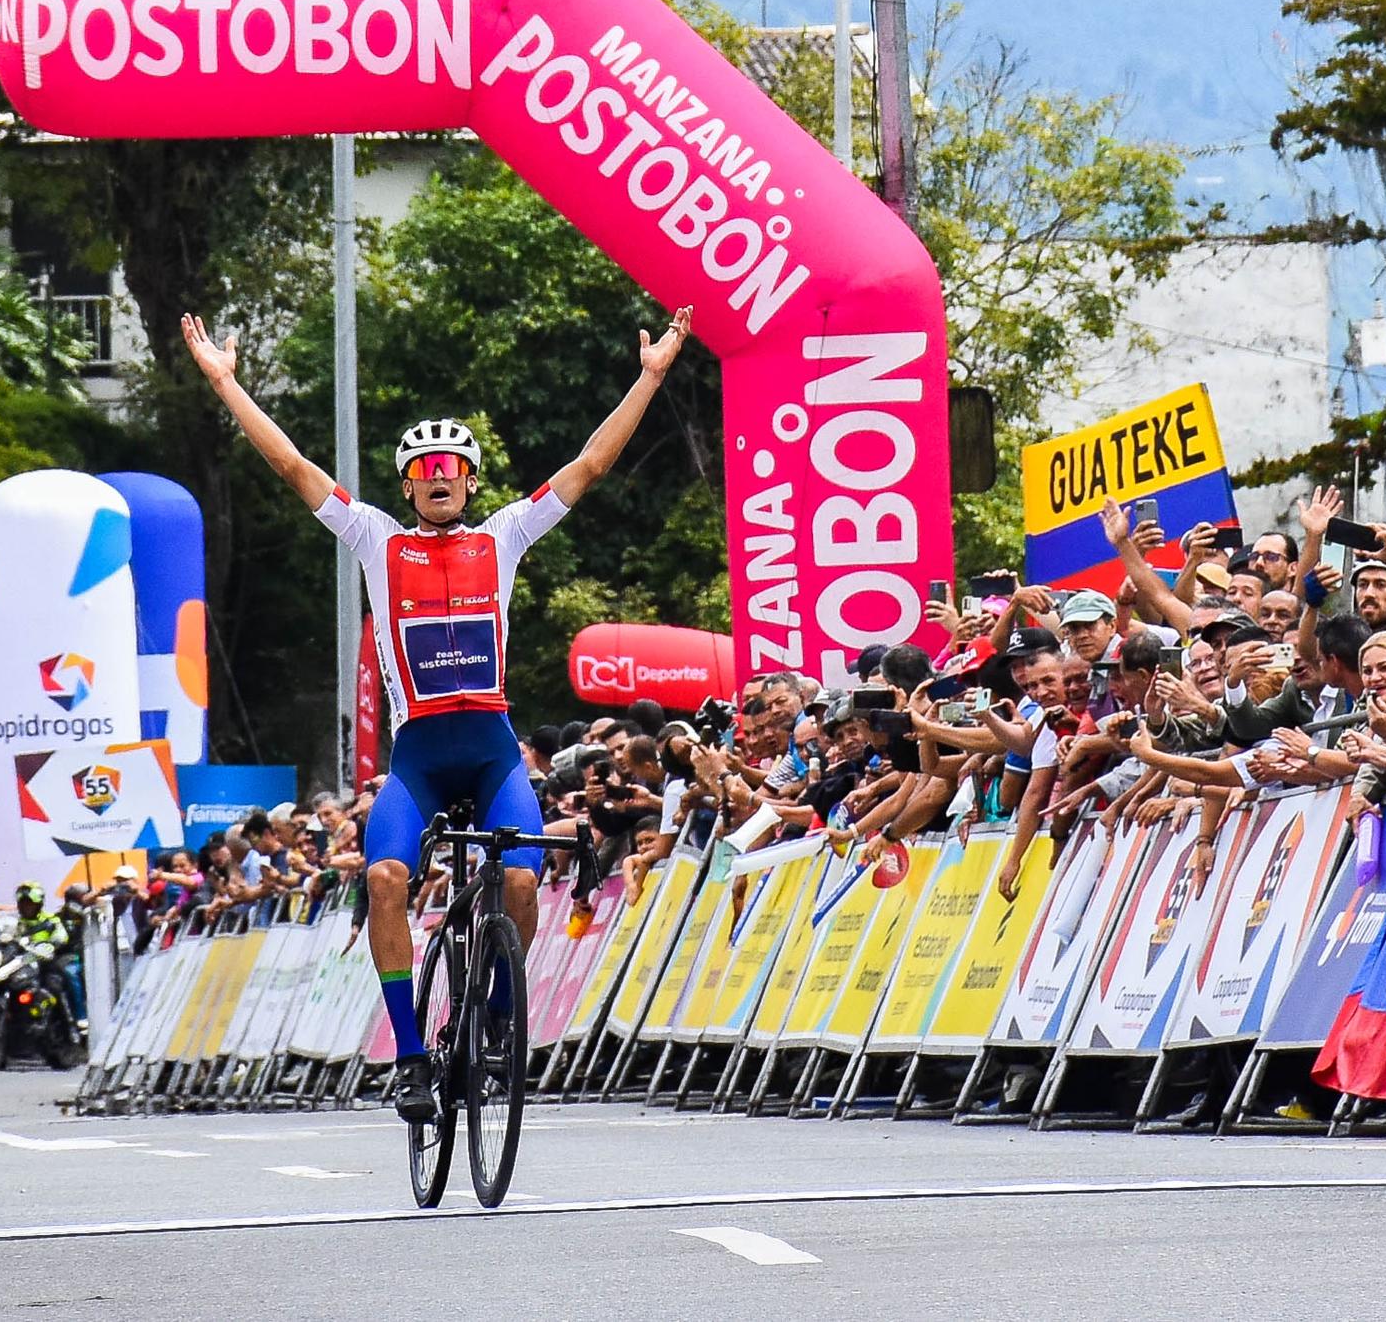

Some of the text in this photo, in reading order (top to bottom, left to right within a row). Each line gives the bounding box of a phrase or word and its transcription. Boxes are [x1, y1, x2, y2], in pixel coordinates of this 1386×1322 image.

[591, 26, 770, 200] MANZANA
[1049, 401, 1206, 514] GUATEKE
[399, 552, 430, 565] PUNTOS
[402, 546, 428, 558] LIDER
[436, 650, 462, 659] team
[637, 665, 708, 684] Deportes
[86, 777, 110, 795] 55
